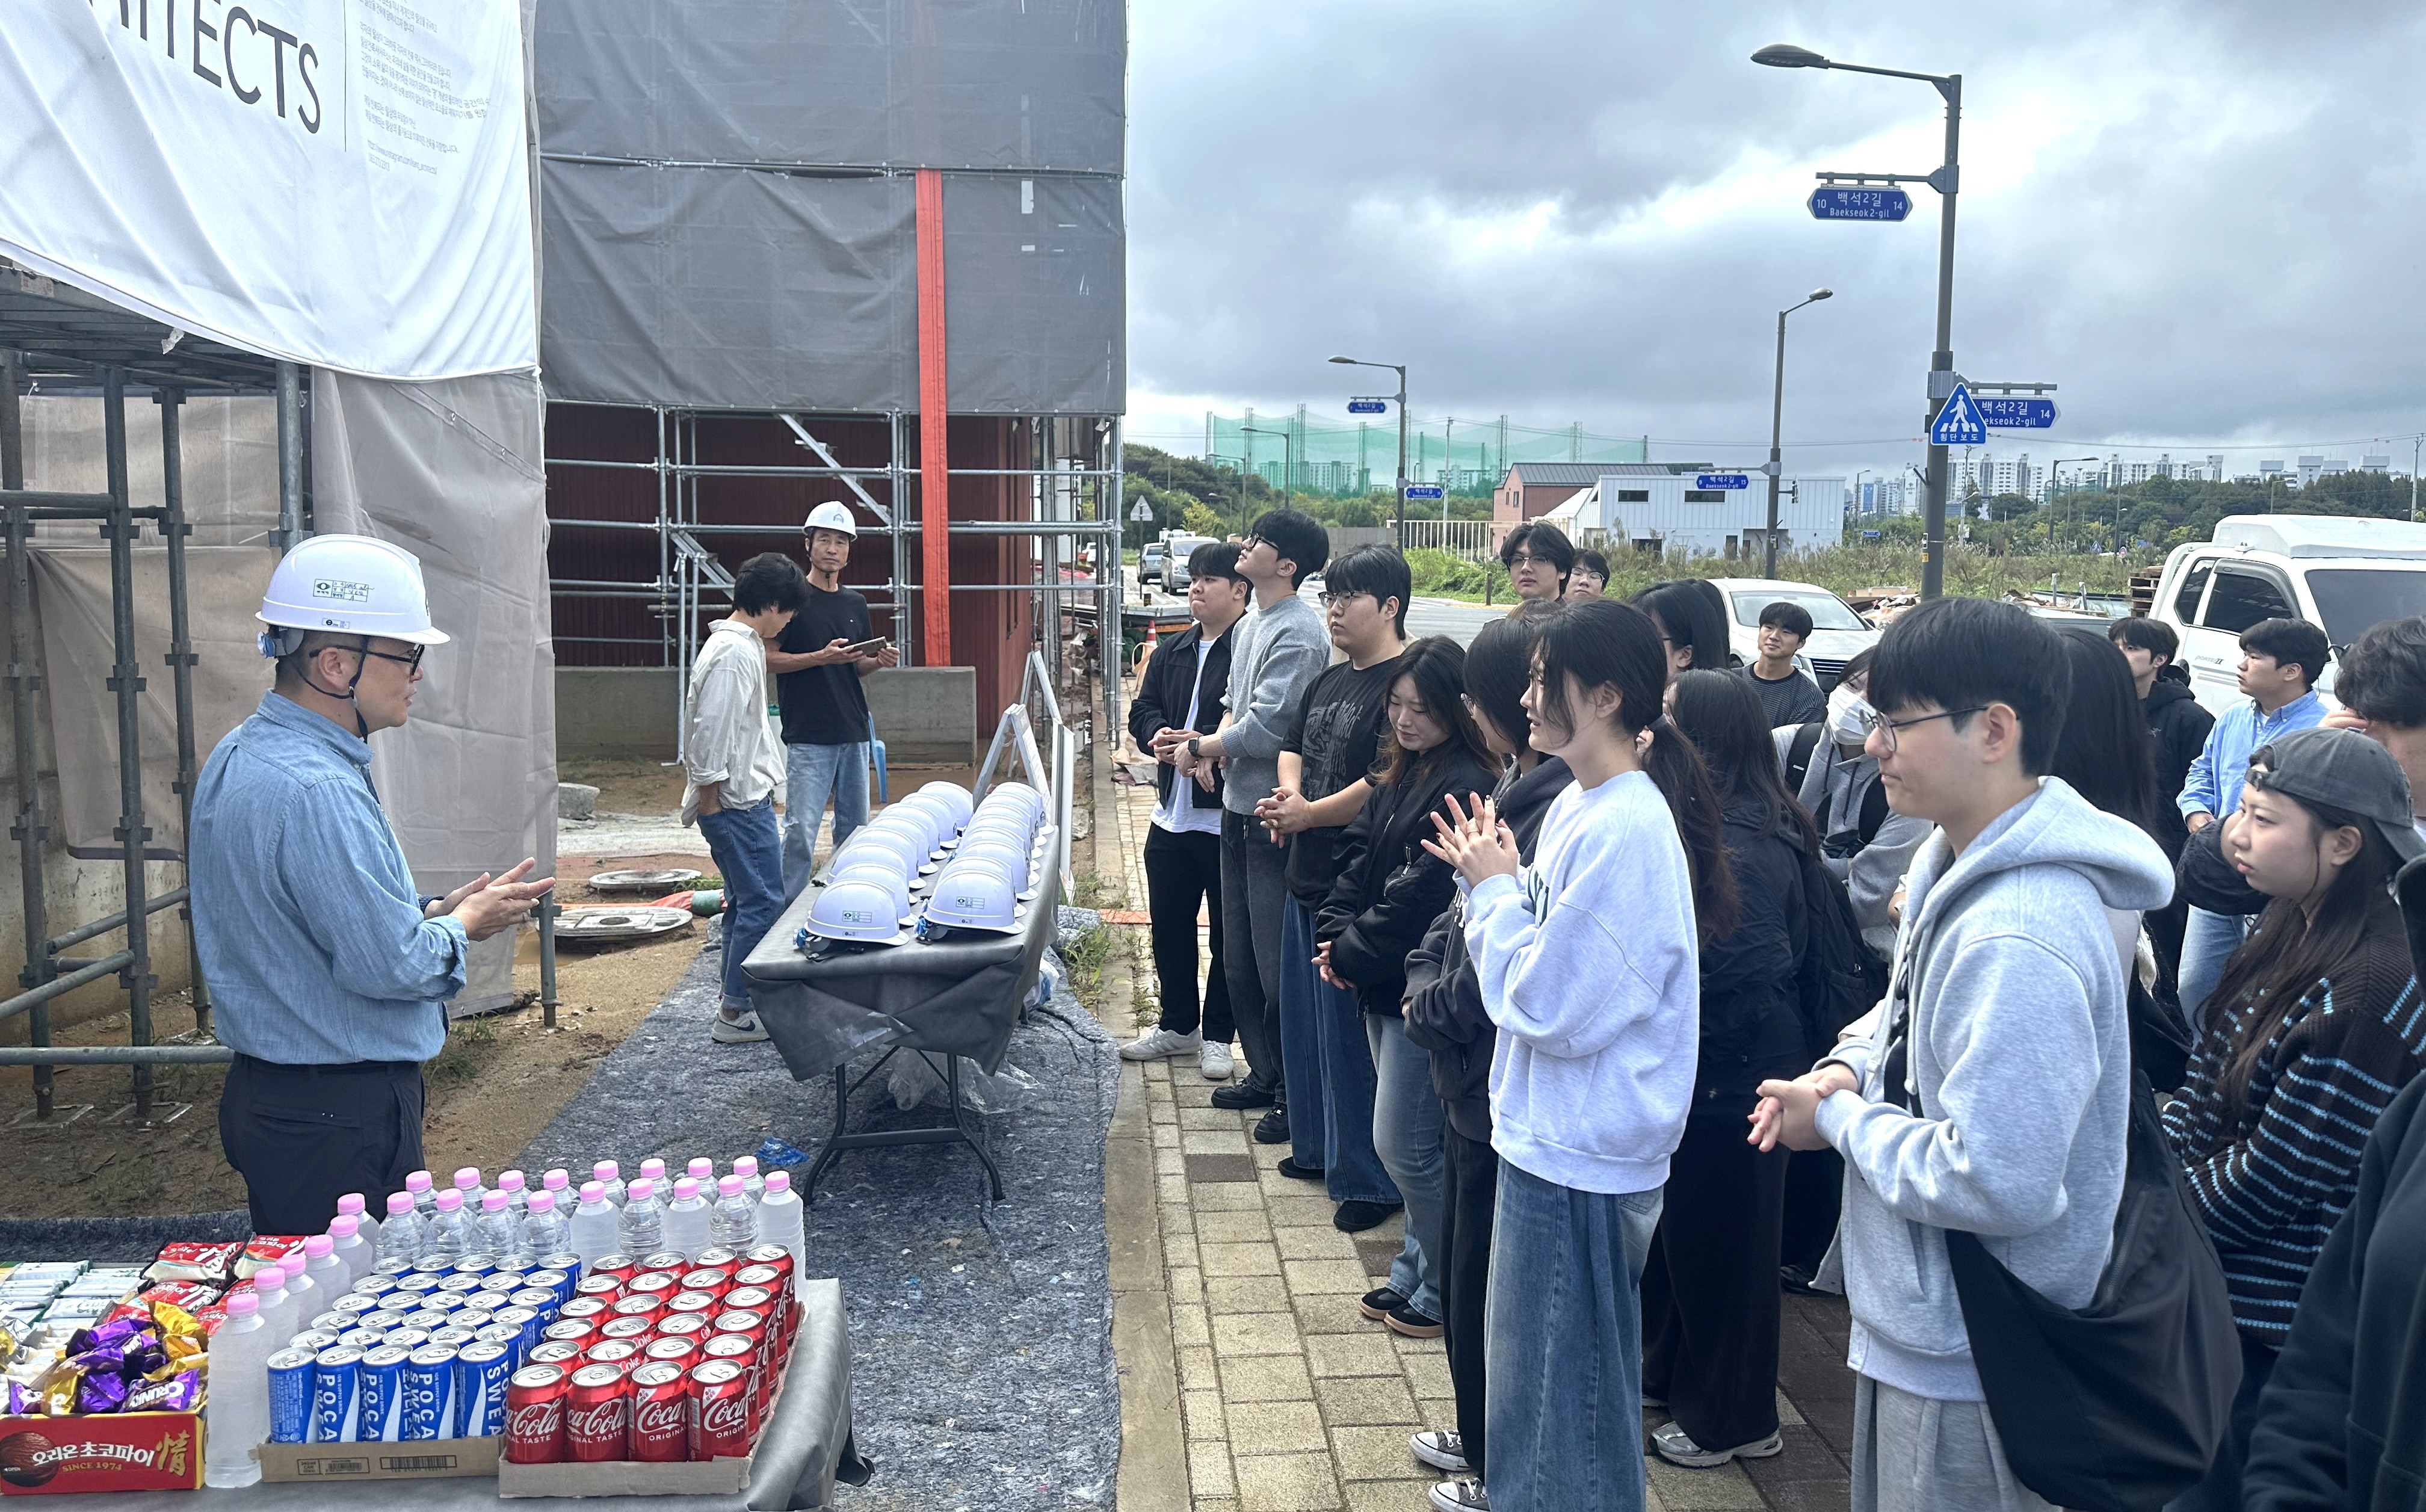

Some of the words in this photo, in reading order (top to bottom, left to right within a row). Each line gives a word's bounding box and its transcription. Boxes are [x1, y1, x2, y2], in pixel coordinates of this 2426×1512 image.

[1817, 199, 1827, 209] 10
[1838, 192, 1881, 207] 백석2길
[1894, 202, 1903, 211] 14
[1830, 208, 1868, 217] Baekseok
[1870, 209, 1889, 219] 2-gil
[1982, 401, 2028, 416] 백석2길
[2040, 409, 2051, 419] 14
[1985, 417, 2014, 426] ekseok
[2016, 417, 2036, 427] 2-gil
[1940, 433, 1978, 442] 횡단보도
[321, 1374, 338, 1440] POCA
[365, 1374, 380, 1439] POCA
[410, 1371, 421, 1439] SWEA
[419, 1373, 435, 1439] POCA
[487, 1366, 501, 1436] SWEA
[523, 1434, 551, 1444] TASTE
[596, 1430, 623, 1442] TASTE
[32, 1444, 78, 1466] 오리온
[80, 1441, 155, 1467] 초코파이
[155, 1429, 191, 1477] 情
[62, 1462, 92, 1472] SINCE
[96, 1461, 123, 1471] 1974
